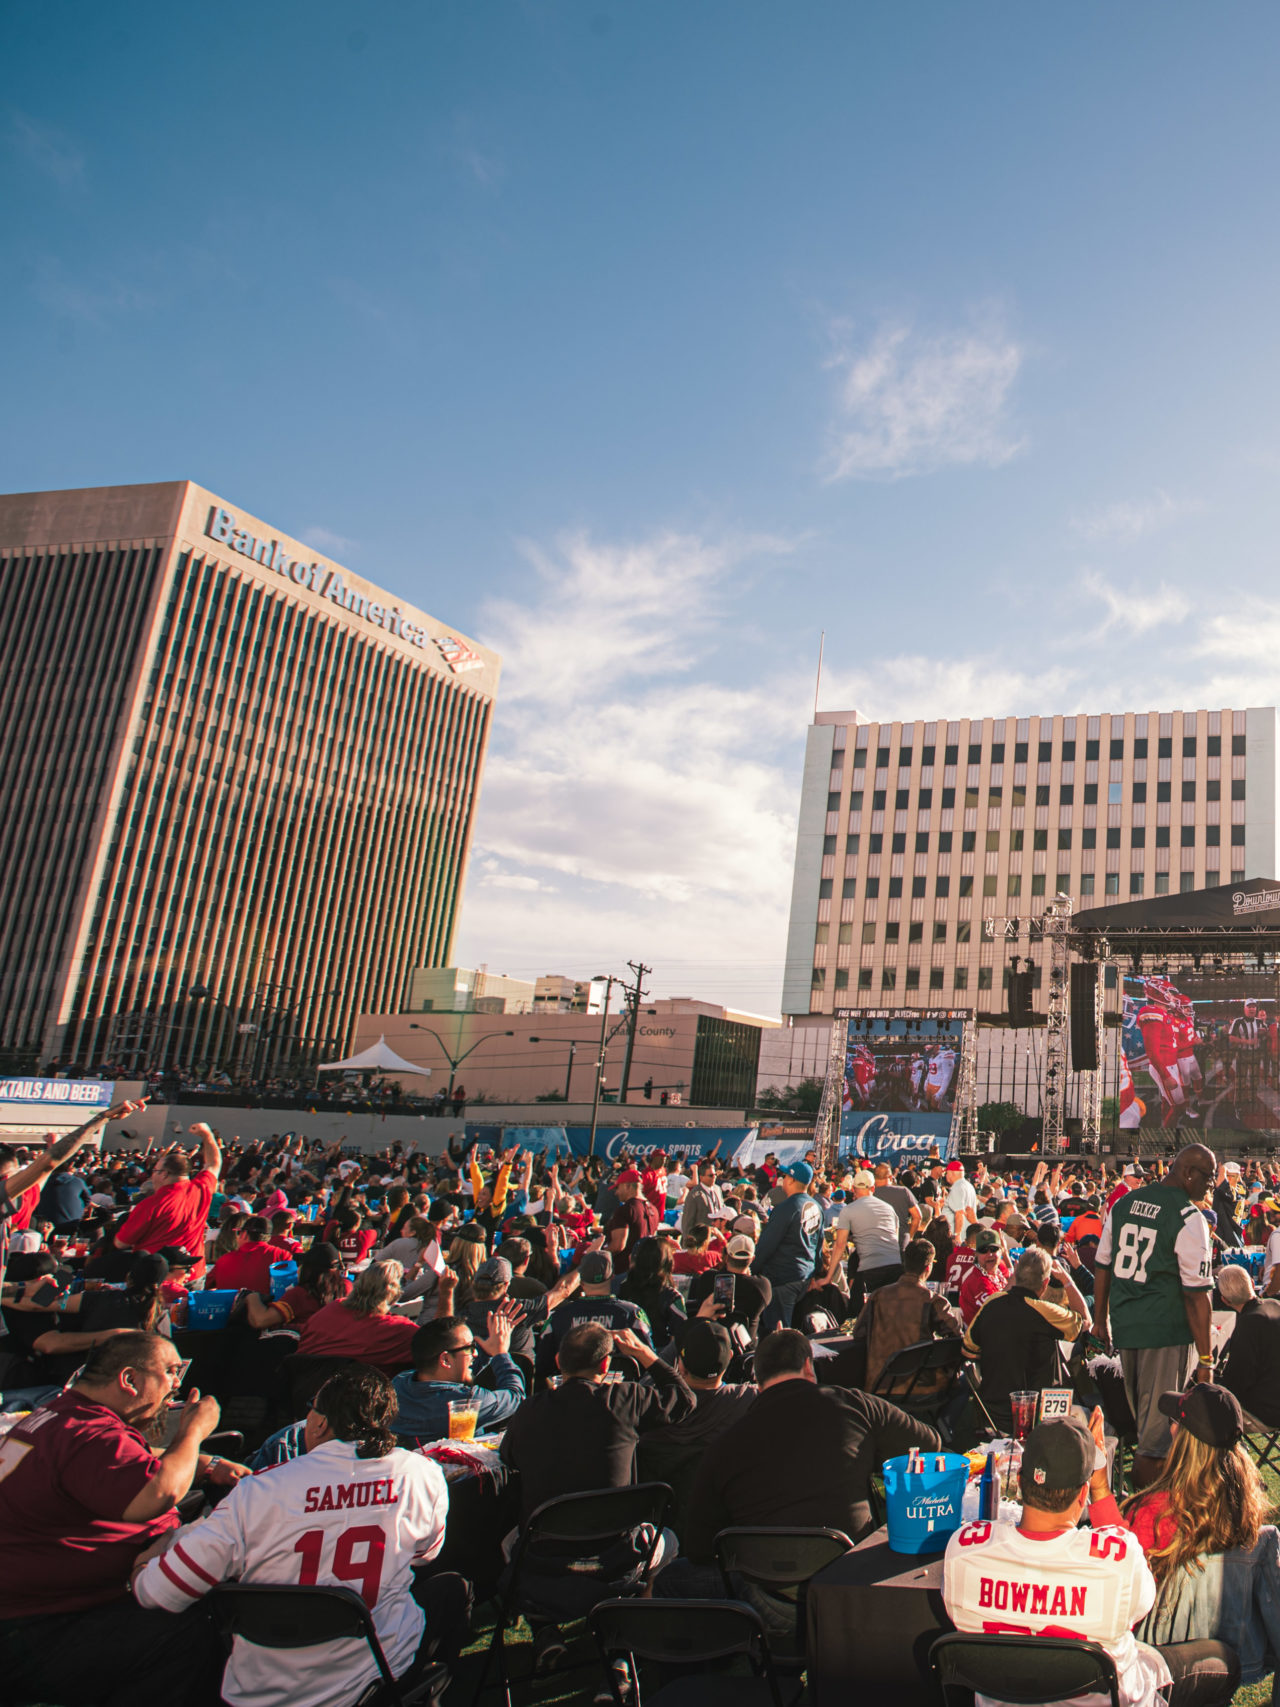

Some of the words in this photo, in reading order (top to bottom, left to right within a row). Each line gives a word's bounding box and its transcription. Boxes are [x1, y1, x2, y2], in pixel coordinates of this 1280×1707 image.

[206, 506, 292, 577] Bank
[290, 561, 326, 592] of
[322, 571, 429, 648] America
[838, 1010, 850, 1018] FREE
[639, 1025, 676, 1038] County
[0, 1080, 43, 1099] KTAILS
[42, 1083, 70, 1100] AND
[69, 1084, 100, 1101] BEER
[606, 1131, 657, 1161] Circa
[668, 1144, 701, 1157] SPORTS
[856, 1114, 936, 1159] Circa
[1129, 1200, 1161, 1219] DECKER
[1113, 1223, 1158, 1284] 87
[1044, 1399, 1068, 1414] 279
[303, 1479, 399, 1514] SAMUEL
[911, 1494, 950, 1506] Michelob
[906, 1504, 954, 1519] ULTRA
[294, 1524, 386, 1614] 19
[978, 1577, 1088, 1618] BOWMAN
